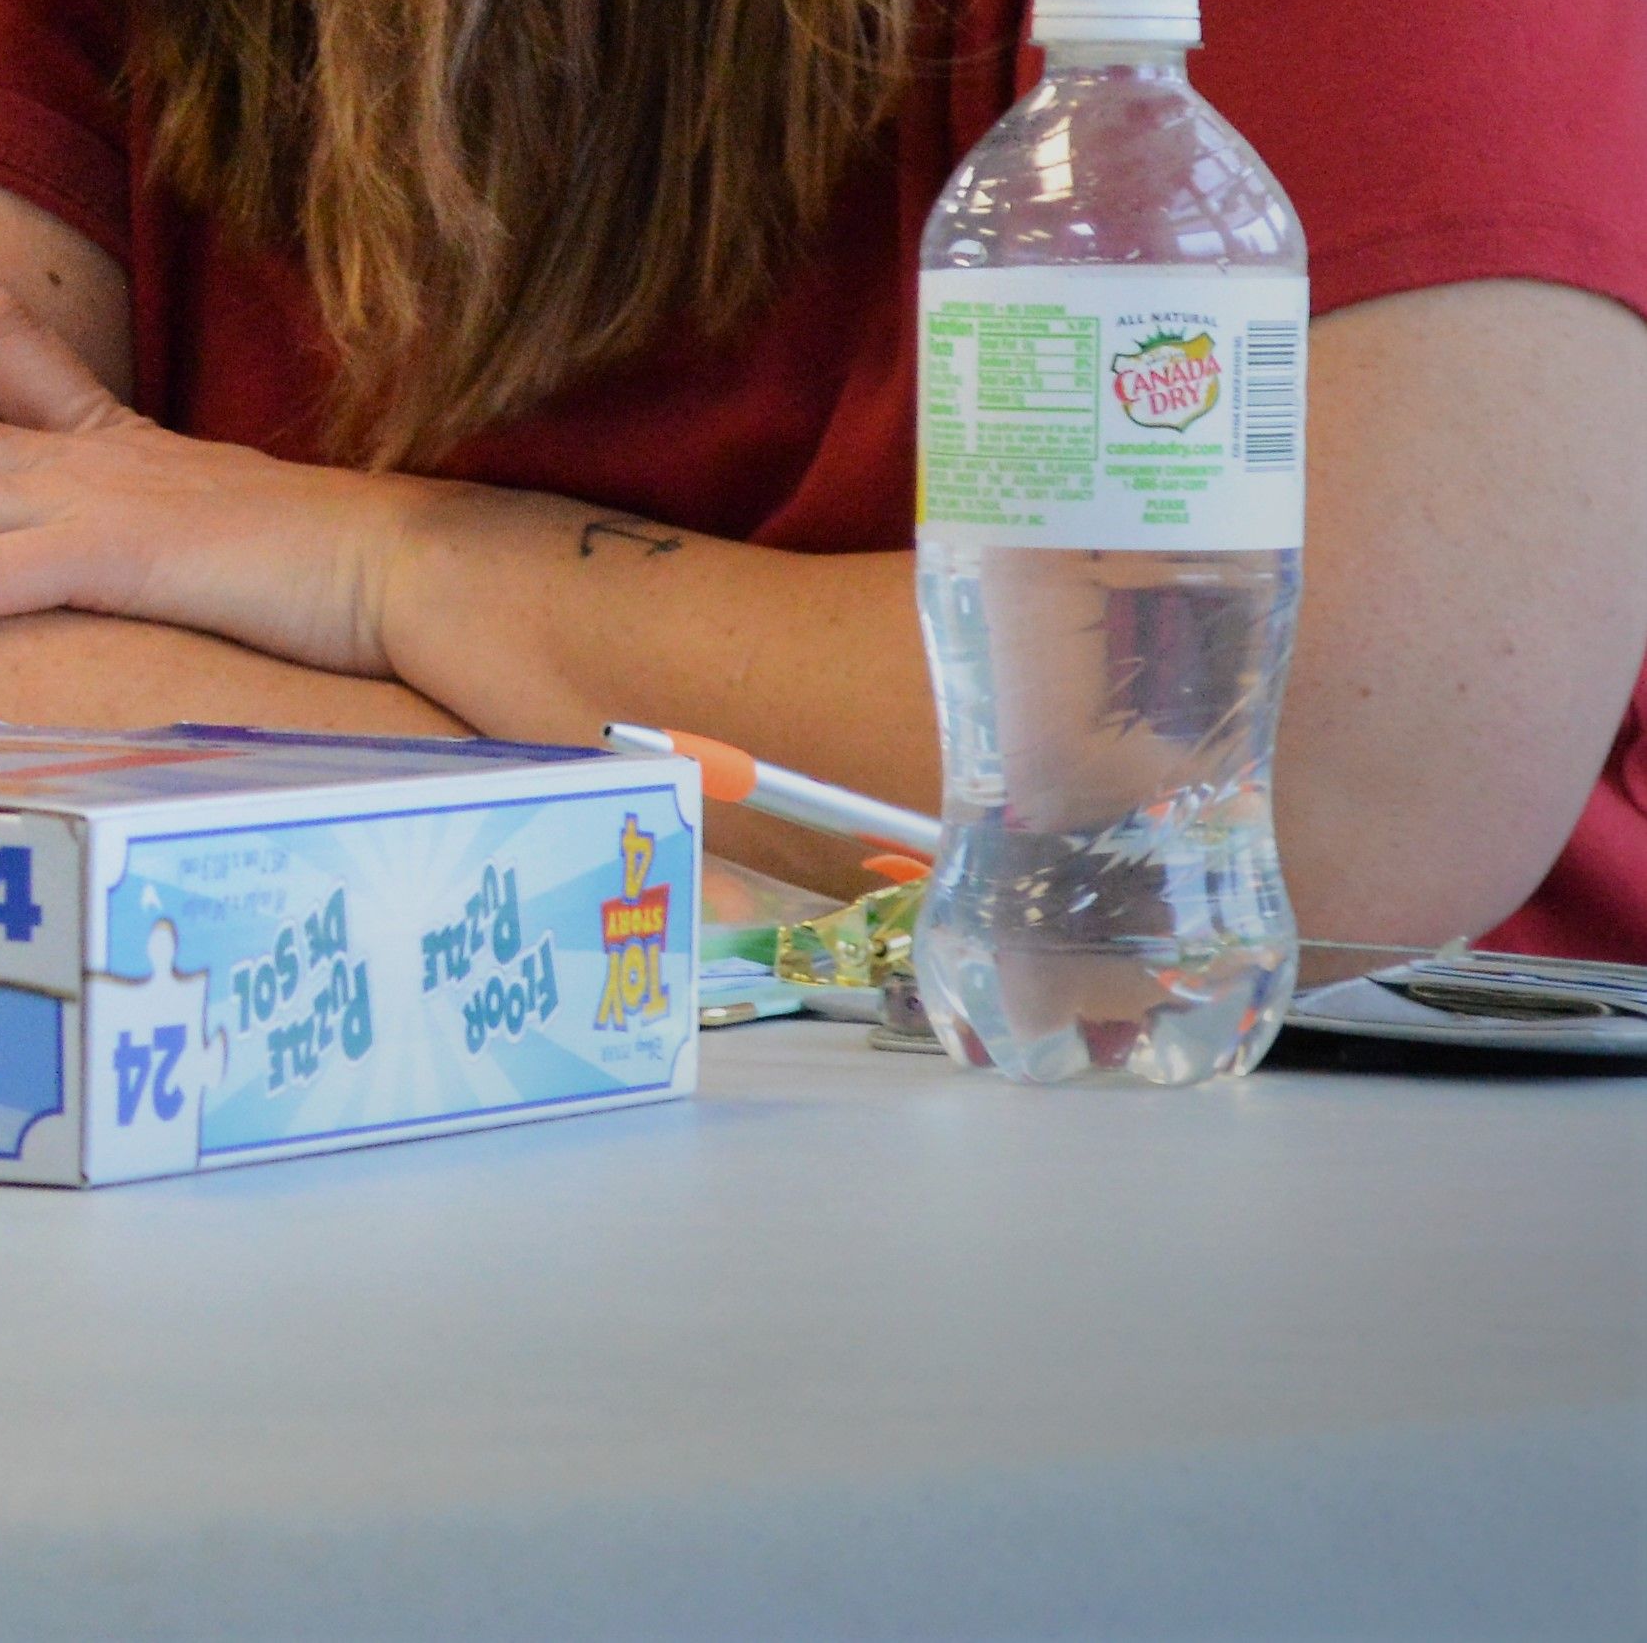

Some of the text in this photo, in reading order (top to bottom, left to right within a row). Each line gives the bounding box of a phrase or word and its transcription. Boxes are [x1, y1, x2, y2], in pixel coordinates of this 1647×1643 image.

[1115, 311, 1218, 328] ALL NATURAL
[1114, 355, 1222, 405] CANADA
[1147, 385, 1202, 415] DRY
[620, 812, 655, 905] 4
[234, 888, 347, 1032] DE SOL
[422, 865, 521, 993] PUZZLE
[607, 907, 663, 936] STORY
[267, 958, 373, 1091] PUZZLE
[463, 938, 559, 1053] FLOOR
[594, 942, 670, 1032] TOY
[114, 1024, 186, 1126] 24
